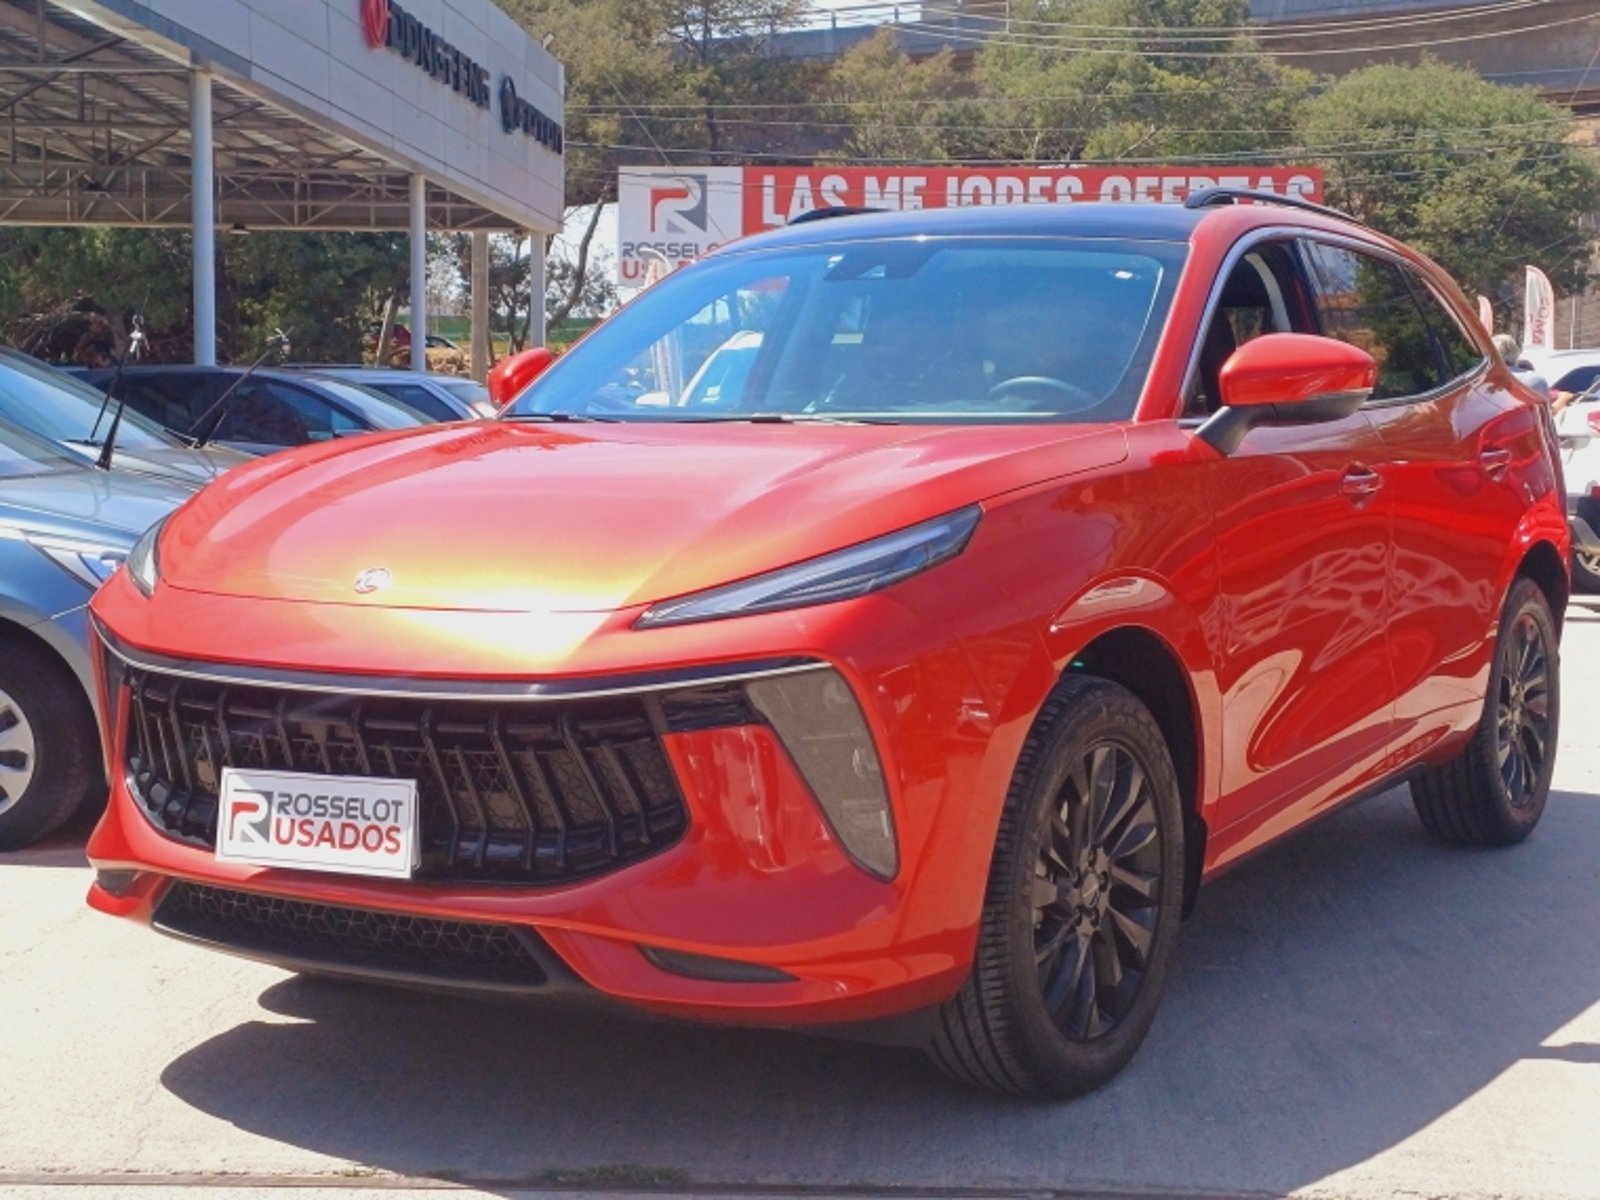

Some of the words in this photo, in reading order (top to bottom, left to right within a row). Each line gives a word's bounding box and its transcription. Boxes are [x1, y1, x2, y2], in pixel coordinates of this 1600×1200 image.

[763, 174, 849, 226] LAS
[276, 792, 404, 823] ROSSELOT
[275, 817, 401, 854] USADOS
